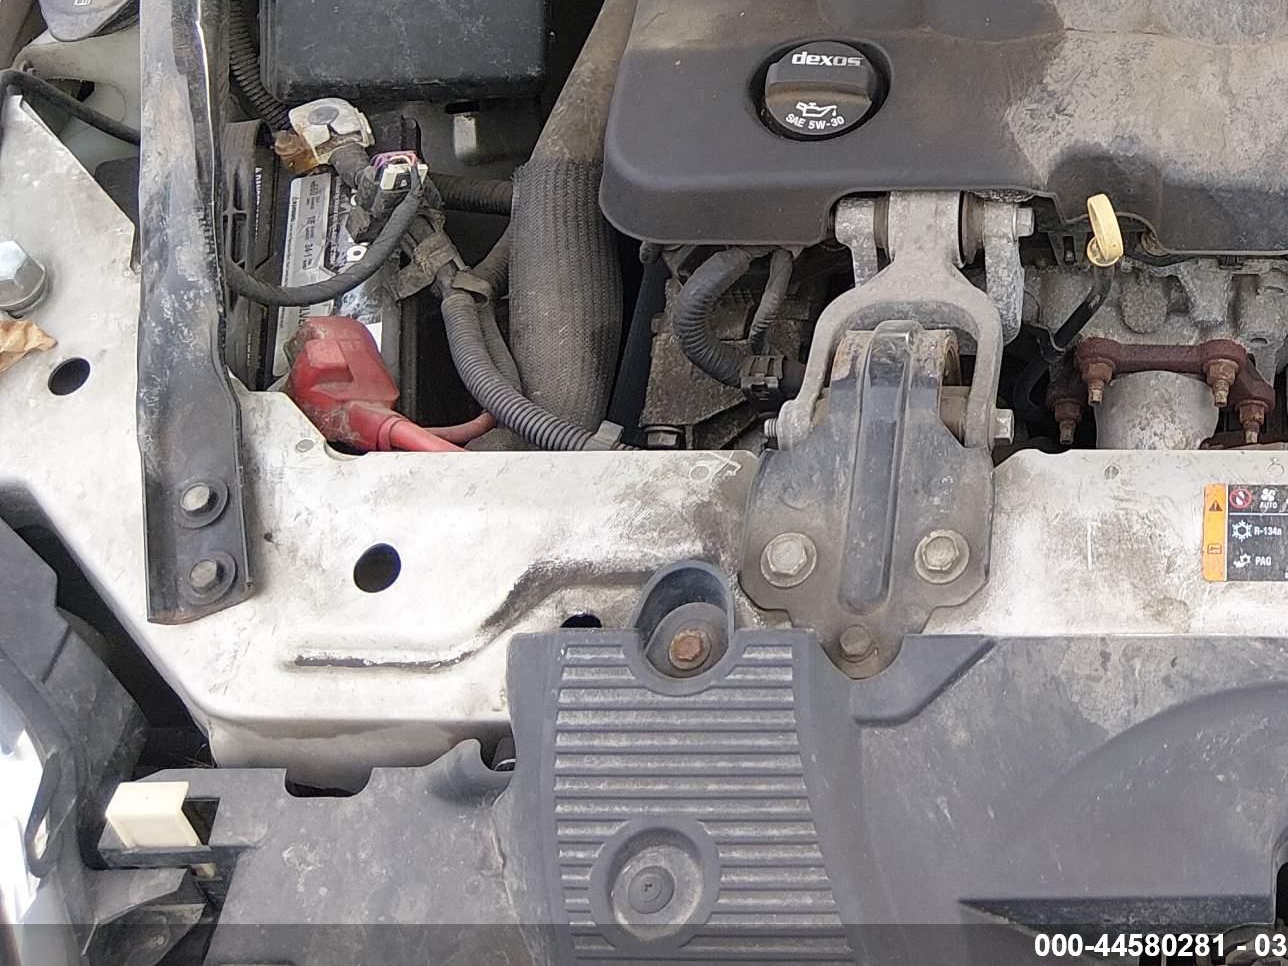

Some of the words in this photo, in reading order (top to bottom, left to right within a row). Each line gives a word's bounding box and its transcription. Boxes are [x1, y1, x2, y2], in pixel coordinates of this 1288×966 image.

[791, 51, 864, 67] dexos
[785, 113, 806, 128] SAE
[808, 115, 845, 130] 5W-30
[1259, 501, 1278, 509] AUTO
[1254, 526, 1282, 536] R-134a
[1255, 556, 1272, 566] PAG
